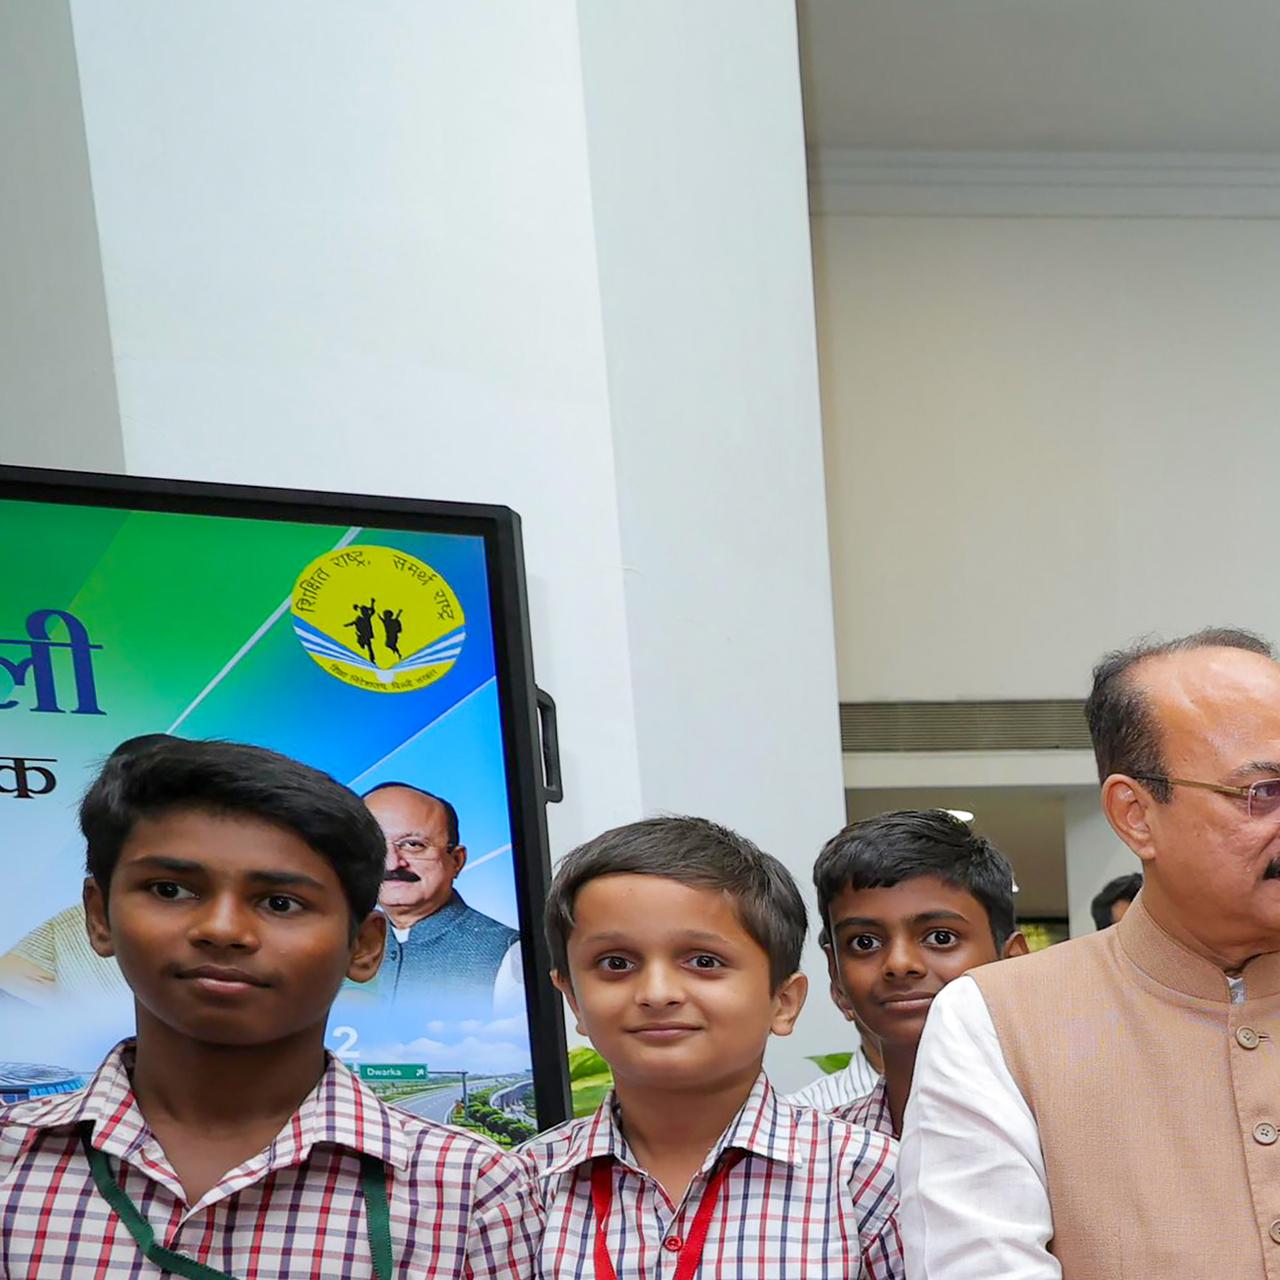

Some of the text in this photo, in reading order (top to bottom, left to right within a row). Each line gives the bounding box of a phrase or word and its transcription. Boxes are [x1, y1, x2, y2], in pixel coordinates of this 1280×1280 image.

[295, 567, 330, 613] शिक्षित
[392, 554, 437, 586] समर्थ
[332, 1026, 361, 1058] 2
[366, 1067, 402, 1077] Dwarka
